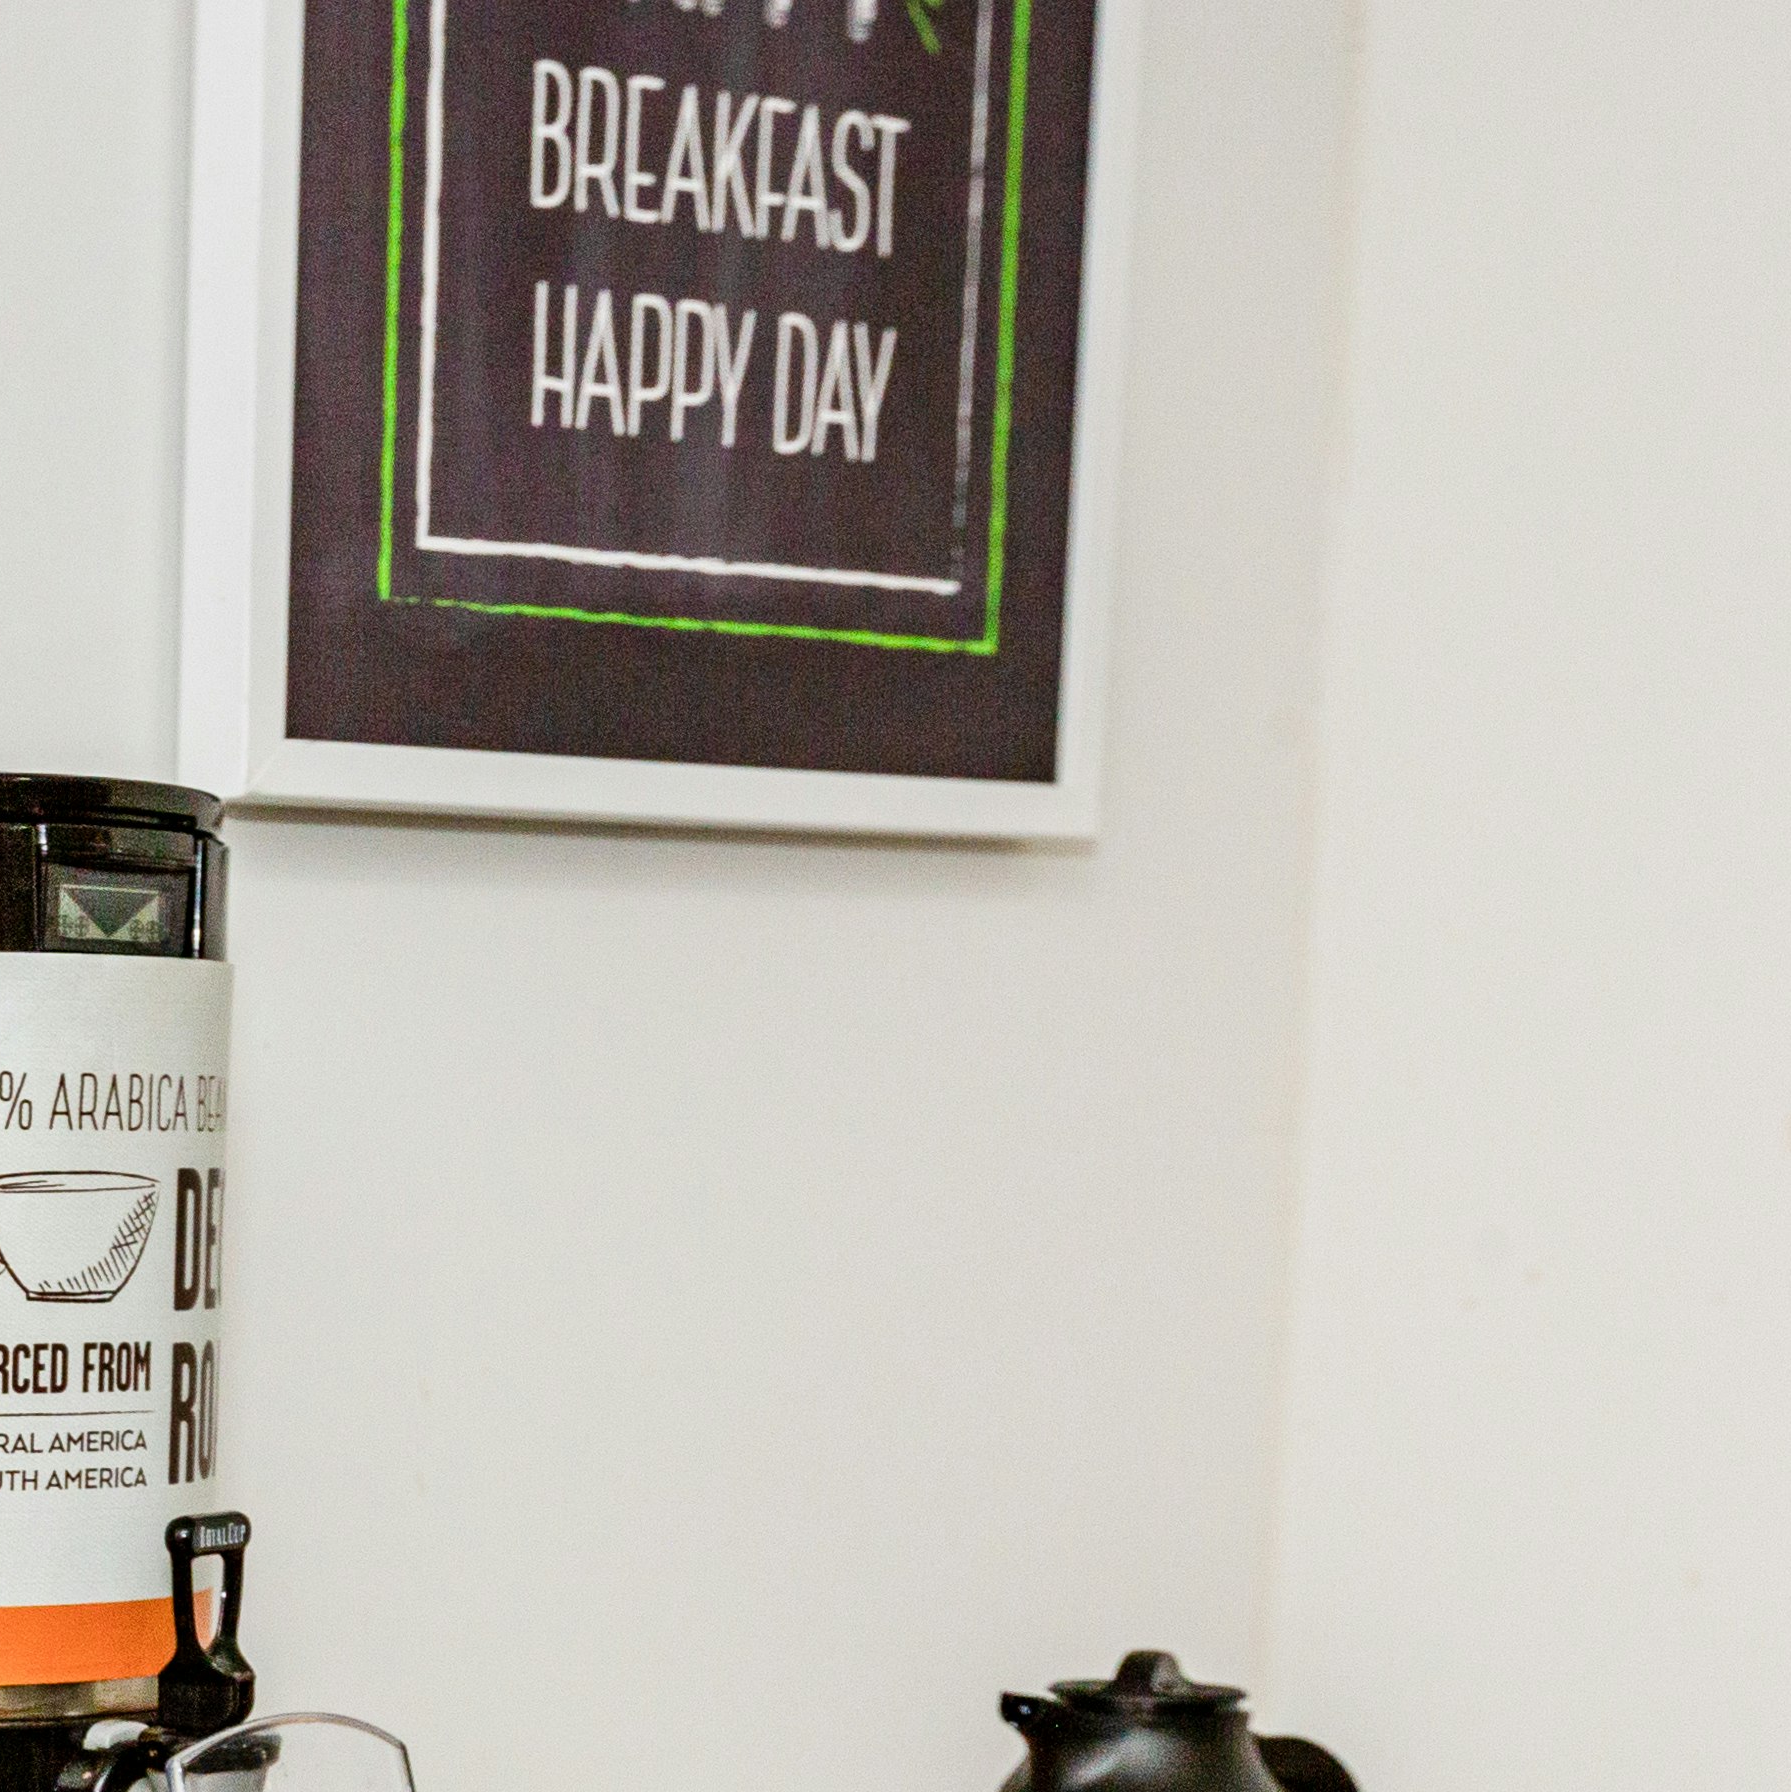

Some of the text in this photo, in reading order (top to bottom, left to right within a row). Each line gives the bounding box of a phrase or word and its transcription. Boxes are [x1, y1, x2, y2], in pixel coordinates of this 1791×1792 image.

[529, 58, 910, 258] BREAKFAST
[530, 280, 897, 463] HAPPY DAY
[48, 1072, 190, 1133] ARABICA
[173, 1168, 225, 1311] DE
[81, 1340, 153, 1394] FROM
[168, 1339, 220, 1485] RO
[45, 1466, 148, 1491] AMERICA
[48, 1428, 148, 1454] AMERICA
